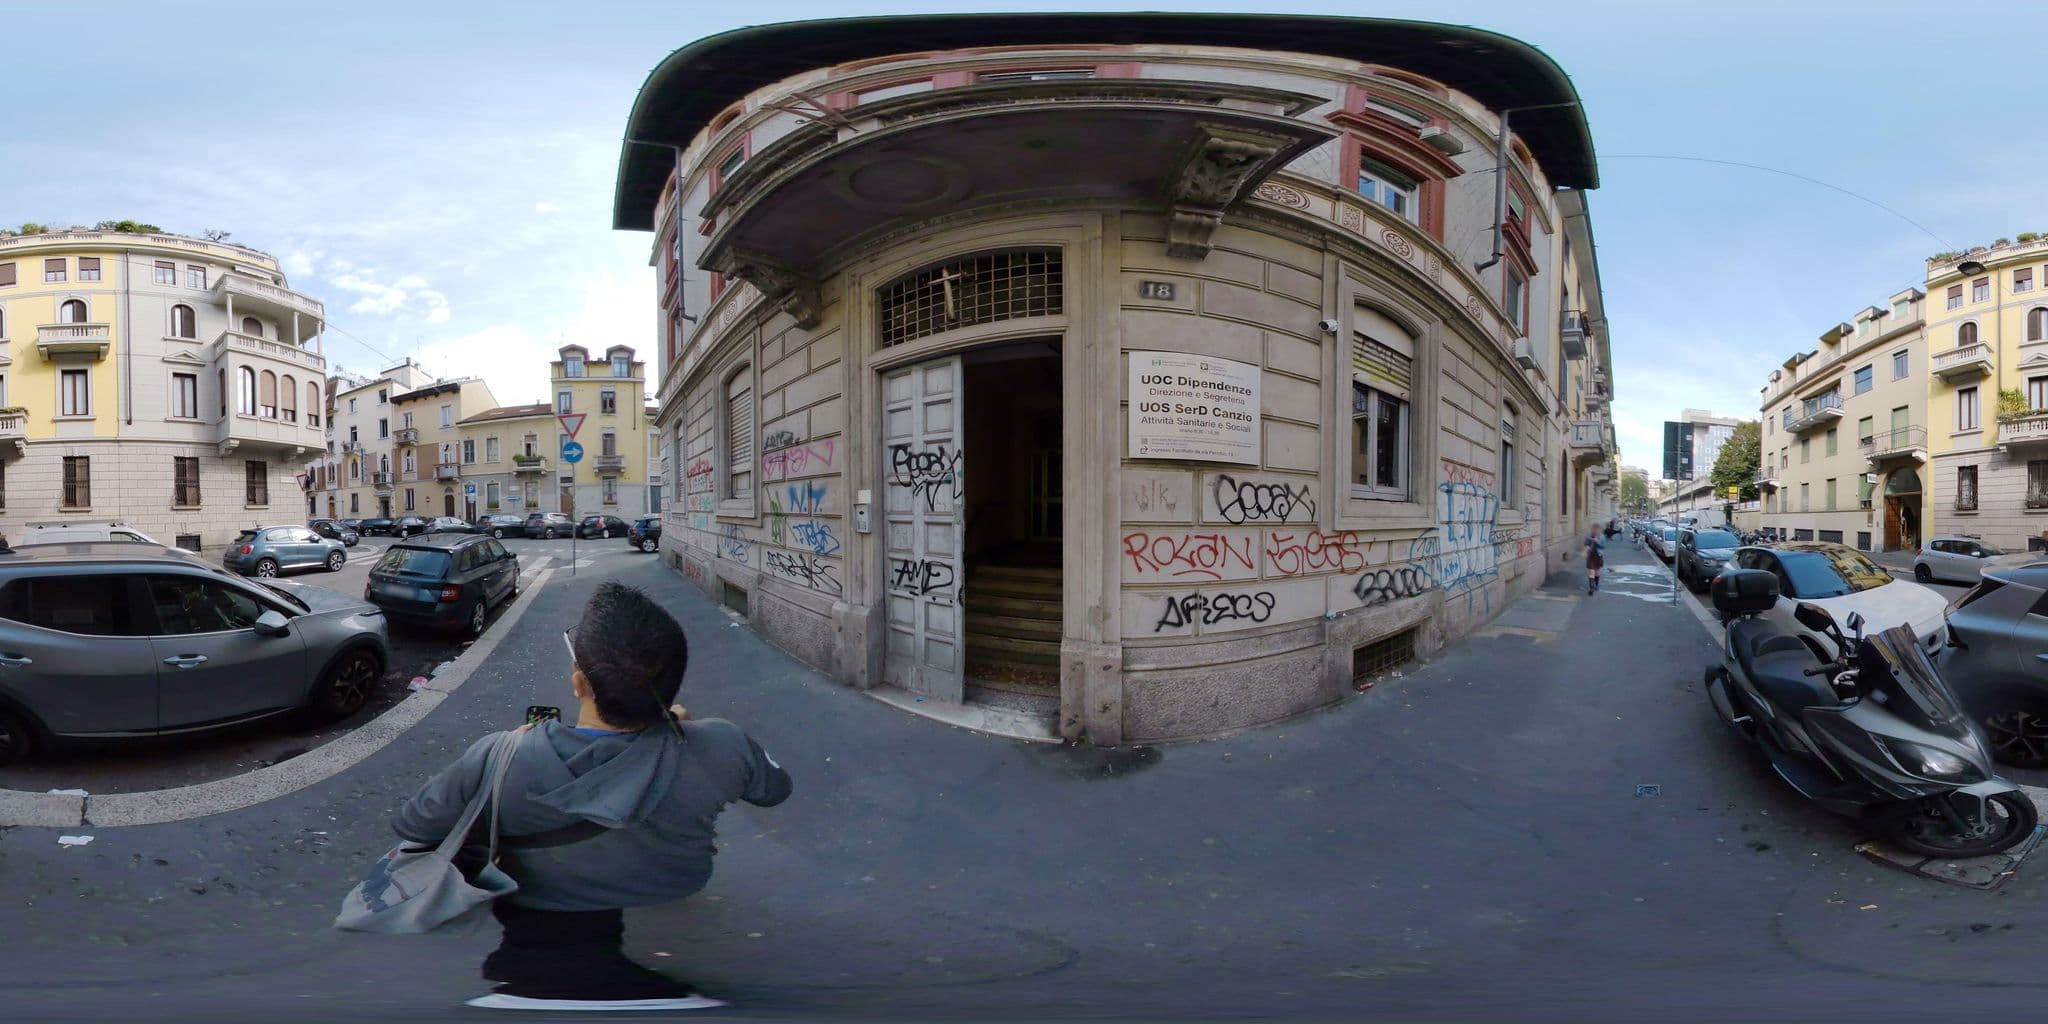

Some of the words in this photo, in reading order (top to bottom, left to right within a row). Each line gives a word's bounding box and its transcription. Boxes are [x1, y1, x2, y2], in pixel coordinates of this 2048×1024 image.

[1148, 283, 1170, 298] 18
[1141, 375, 1173, 385] UOC
[1178, 376, 1252, 396] Dipendenze
[1149, 388, 1193, 397] Direzione
[1203, 391, 1245, 405] Segreteria
[1140, 402, 1170, 413] UOS
[1175, 403, 1208, 415] SerD
[1212, 407, 1253, 422] Canzio
[1141, 416, 1174, 425] Attività
[1177, 417, 1216, 428] Sanitarie
[1226, 422, 1251, 433] Sociali
